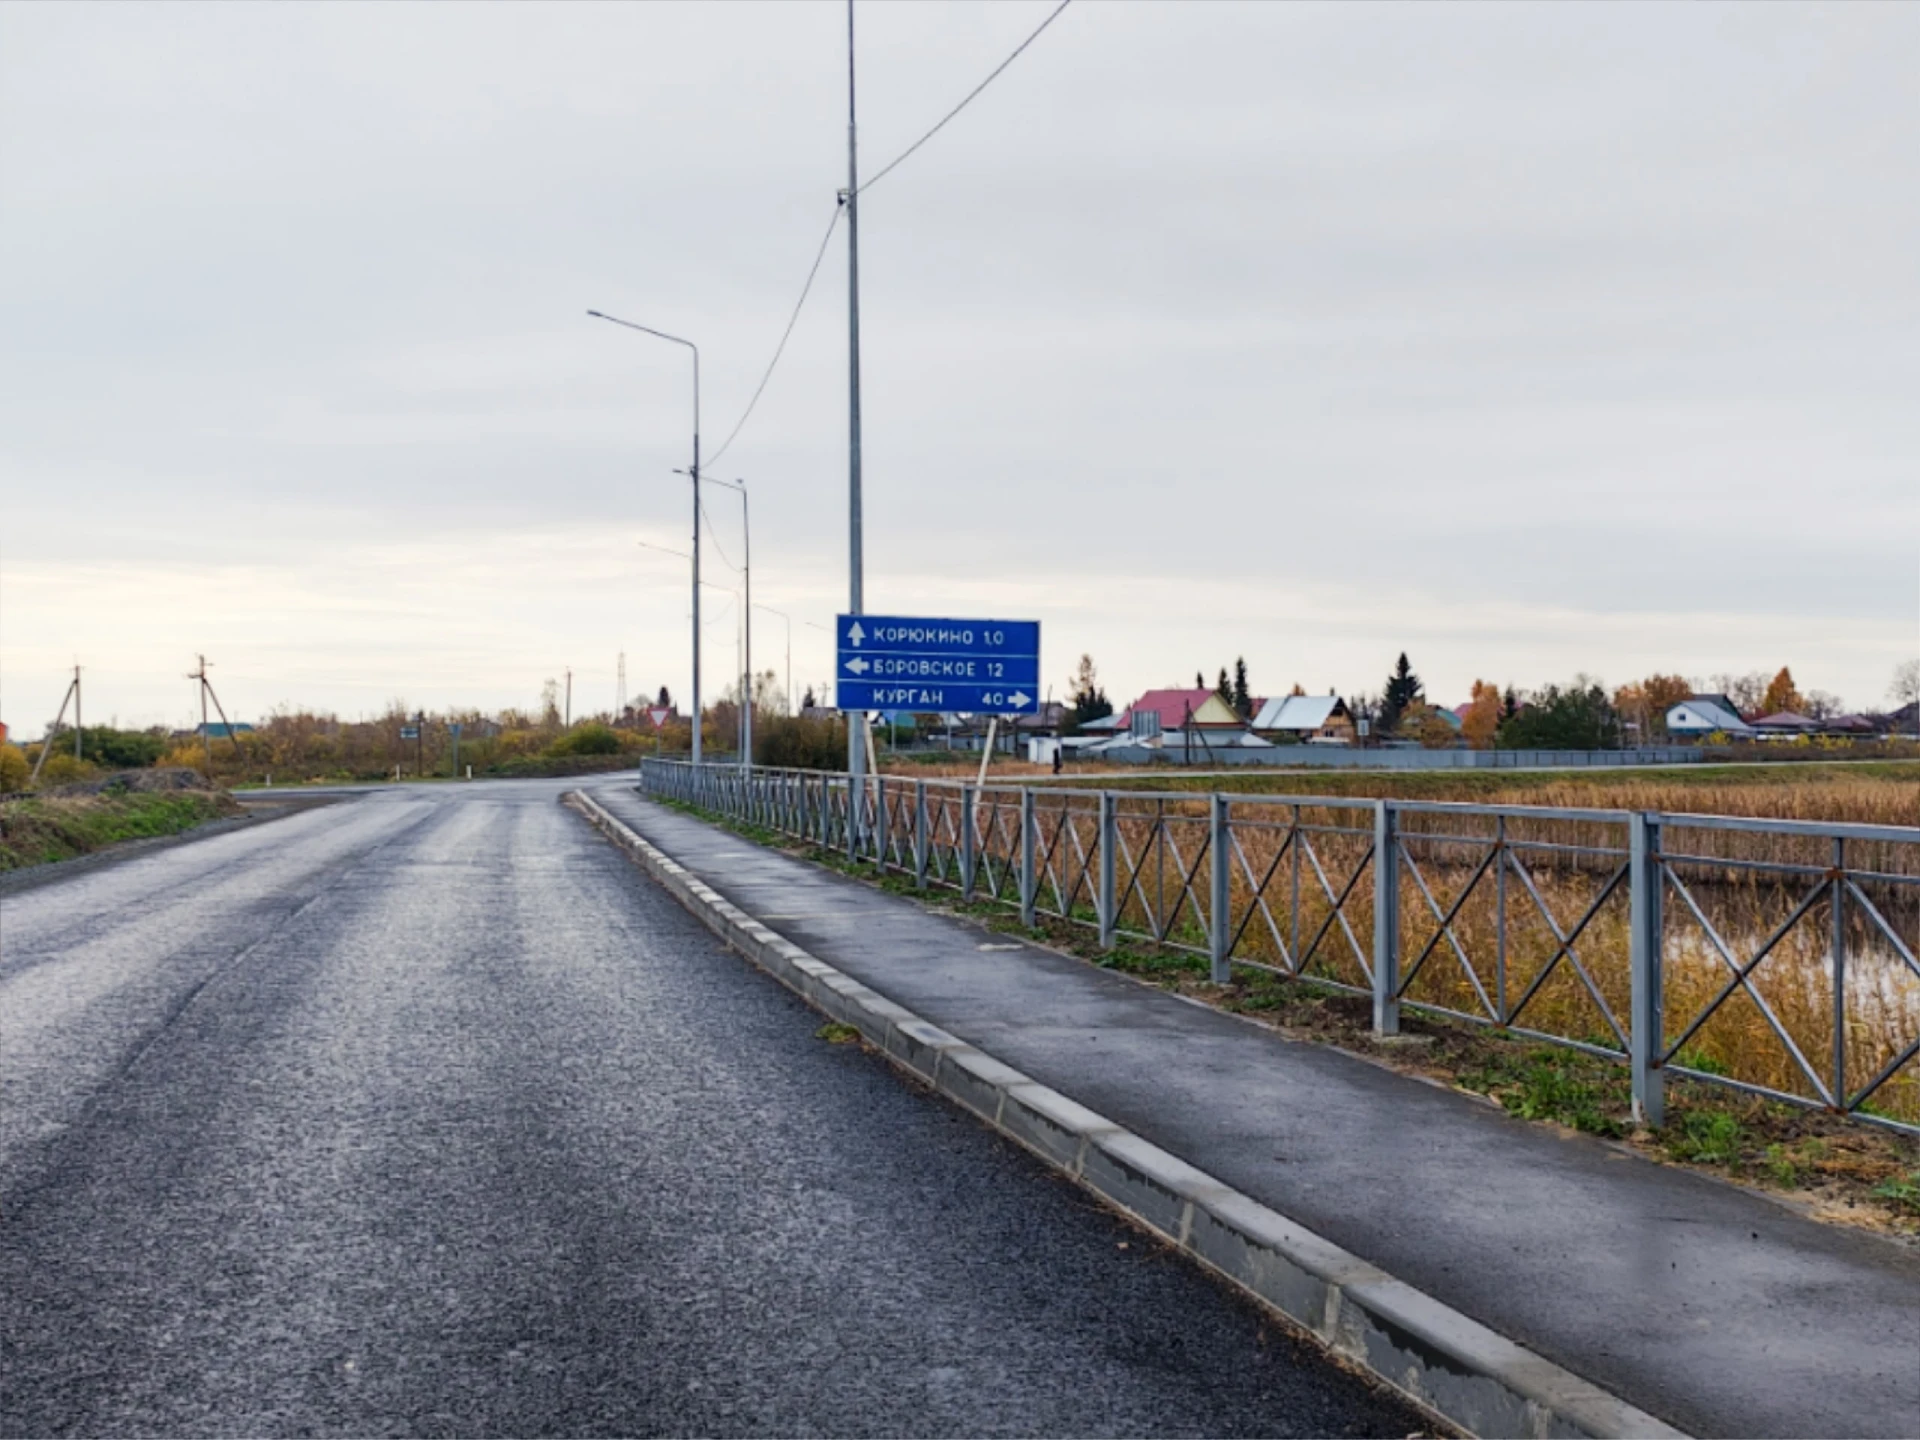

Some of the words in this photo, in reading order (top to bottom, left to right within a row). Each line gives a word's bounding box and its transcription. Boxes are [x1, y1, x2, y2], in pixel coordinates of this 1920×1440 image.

[873, 627, 974, 645] КОРЮКИНО
[873, 659, 976, 677] БОРОВСКОЕ
[986, 662, 1004, 677] 12
[873, 688, 943, 705] КУРГАН
[982, 692, 1004, 706] 40
